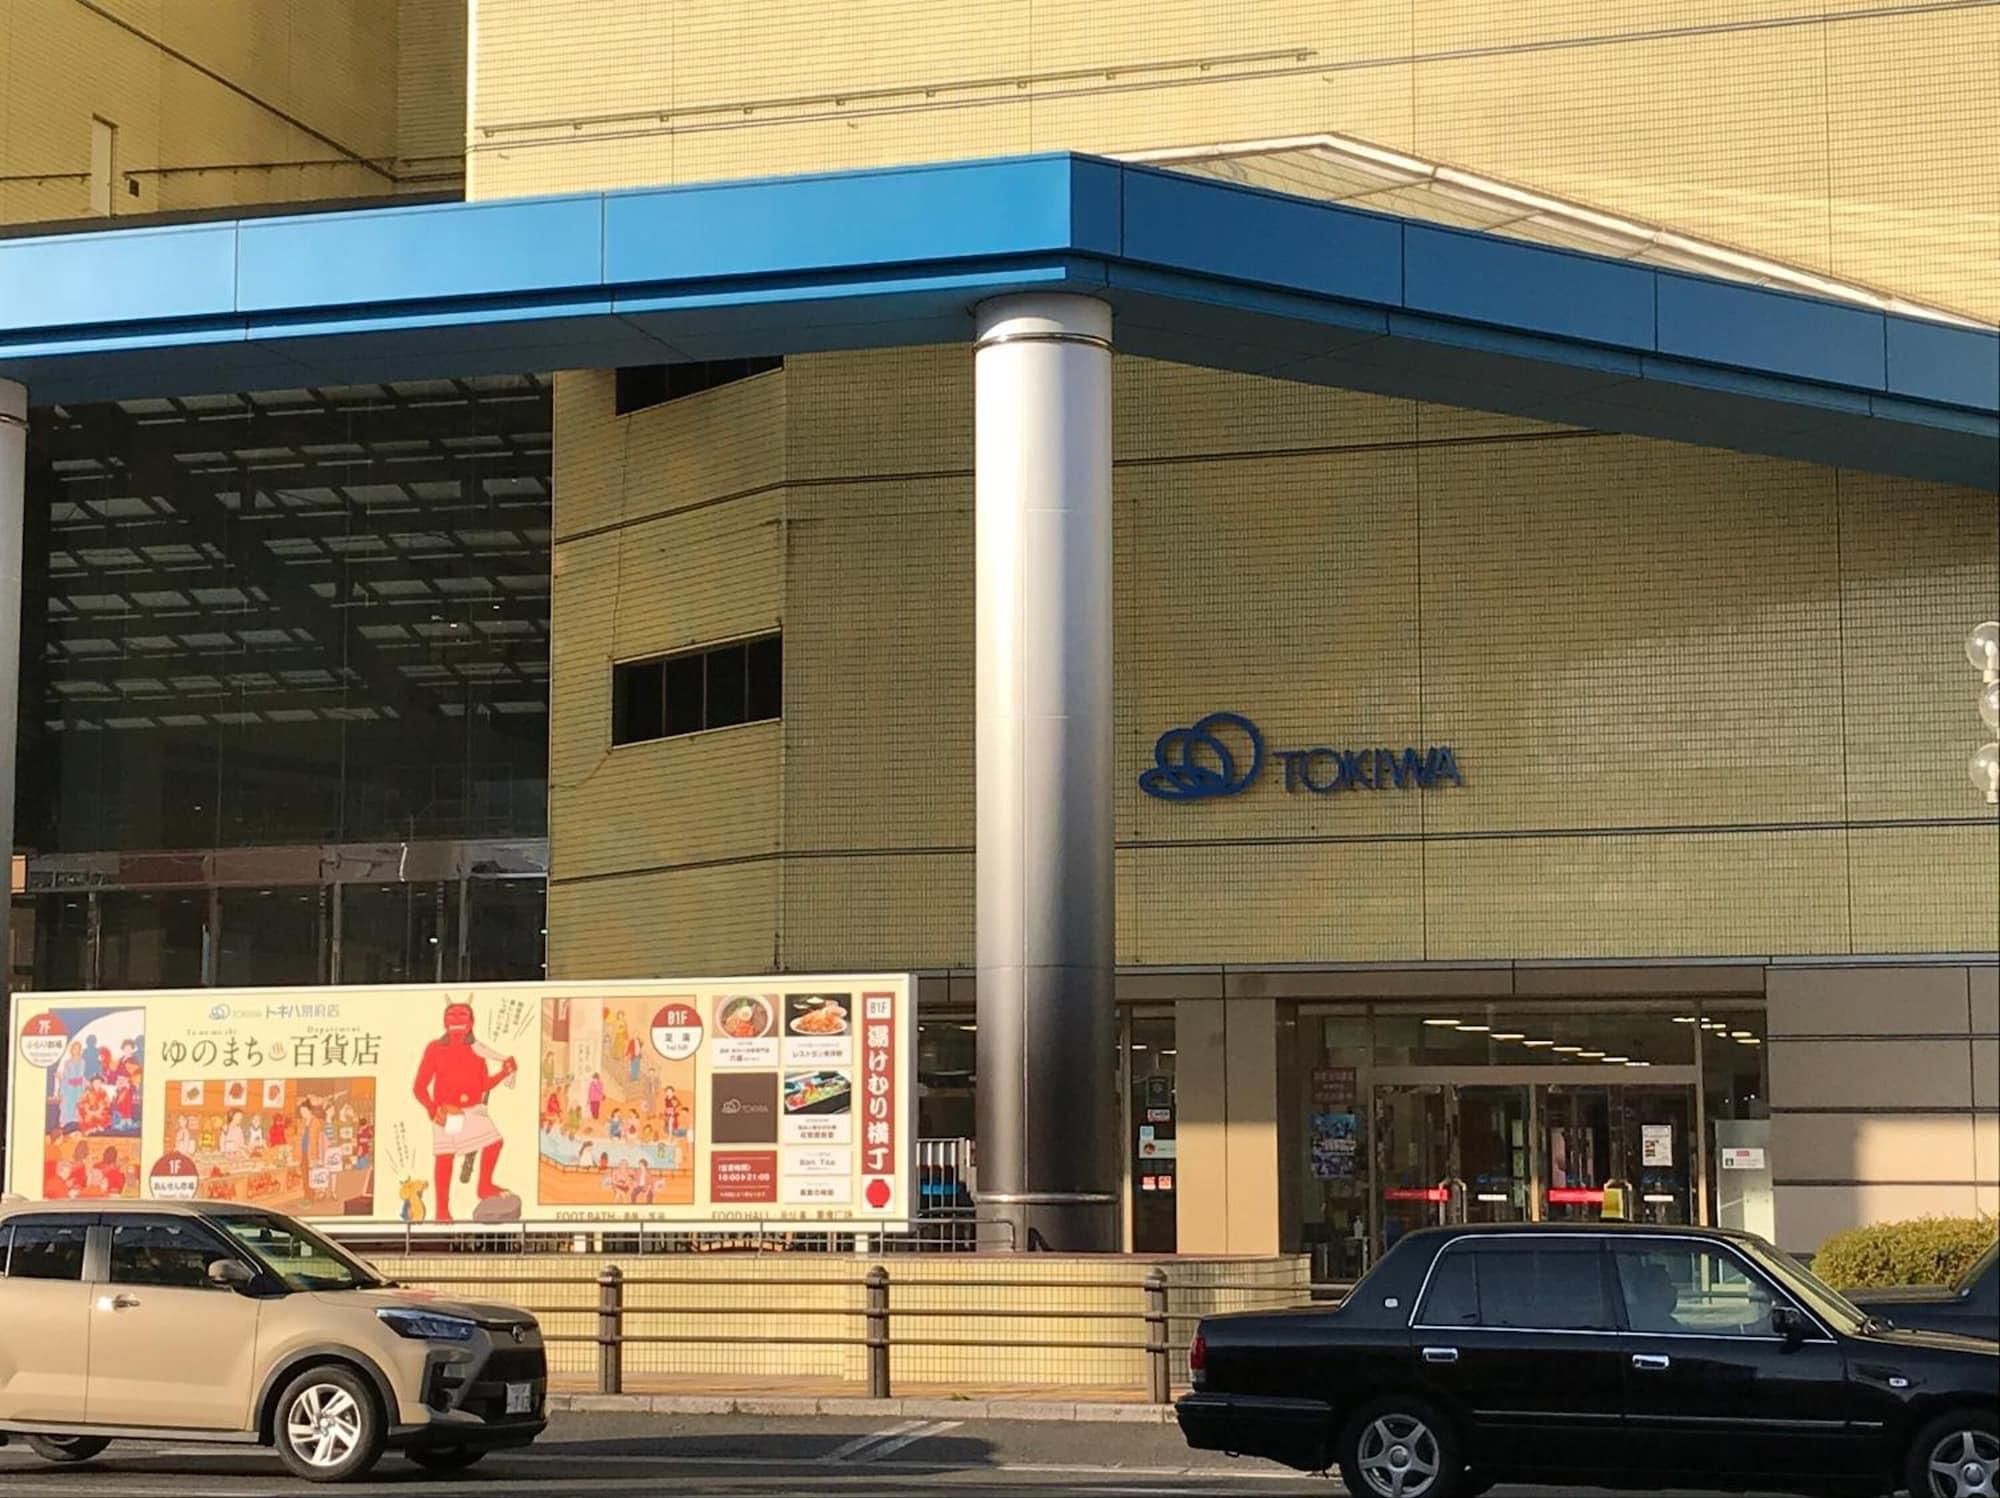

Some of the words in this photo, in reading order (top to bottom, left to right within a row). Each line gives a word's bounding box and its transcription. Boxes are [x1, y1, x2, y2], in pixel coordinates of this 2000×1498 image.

[1274, 746, 1462, 793] TOKIWA
[265, 1004, 340, 1018] トキハ別府店
[870, 1002, 887, 1014] B1F
[667, 1010, 688, 1025] B1F
[161, 1036, 264, 1068] ゆのまち
[290, 1033, 382, 1066] 百貨店
[867, 1025, 889, 1170] 湯けむり横丁
[169, 1160, 182, 1174] 1F
